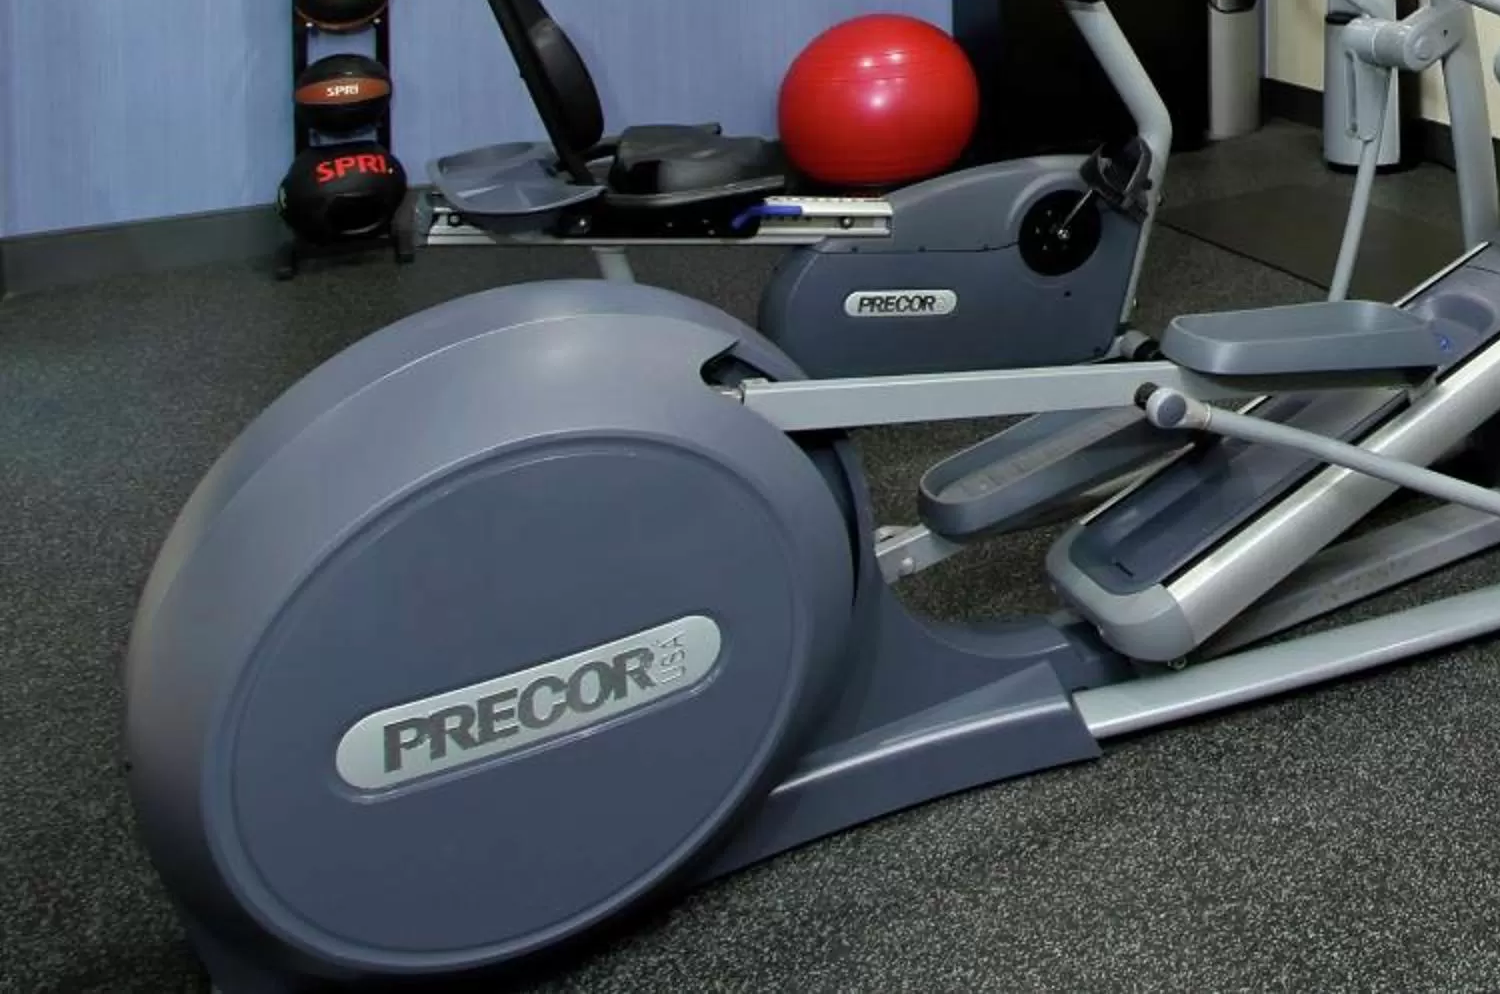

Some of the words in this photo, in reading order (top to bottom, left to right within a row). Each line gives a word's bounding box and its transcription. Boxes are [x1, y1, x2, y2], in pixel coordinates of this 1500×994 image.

[326, 83, 360, 97] SPRI
[315, 153, 387, 183] SPRI
[857, 295, 937, 314] PRECOR
[383, 646, 656, 774] PRECOR
